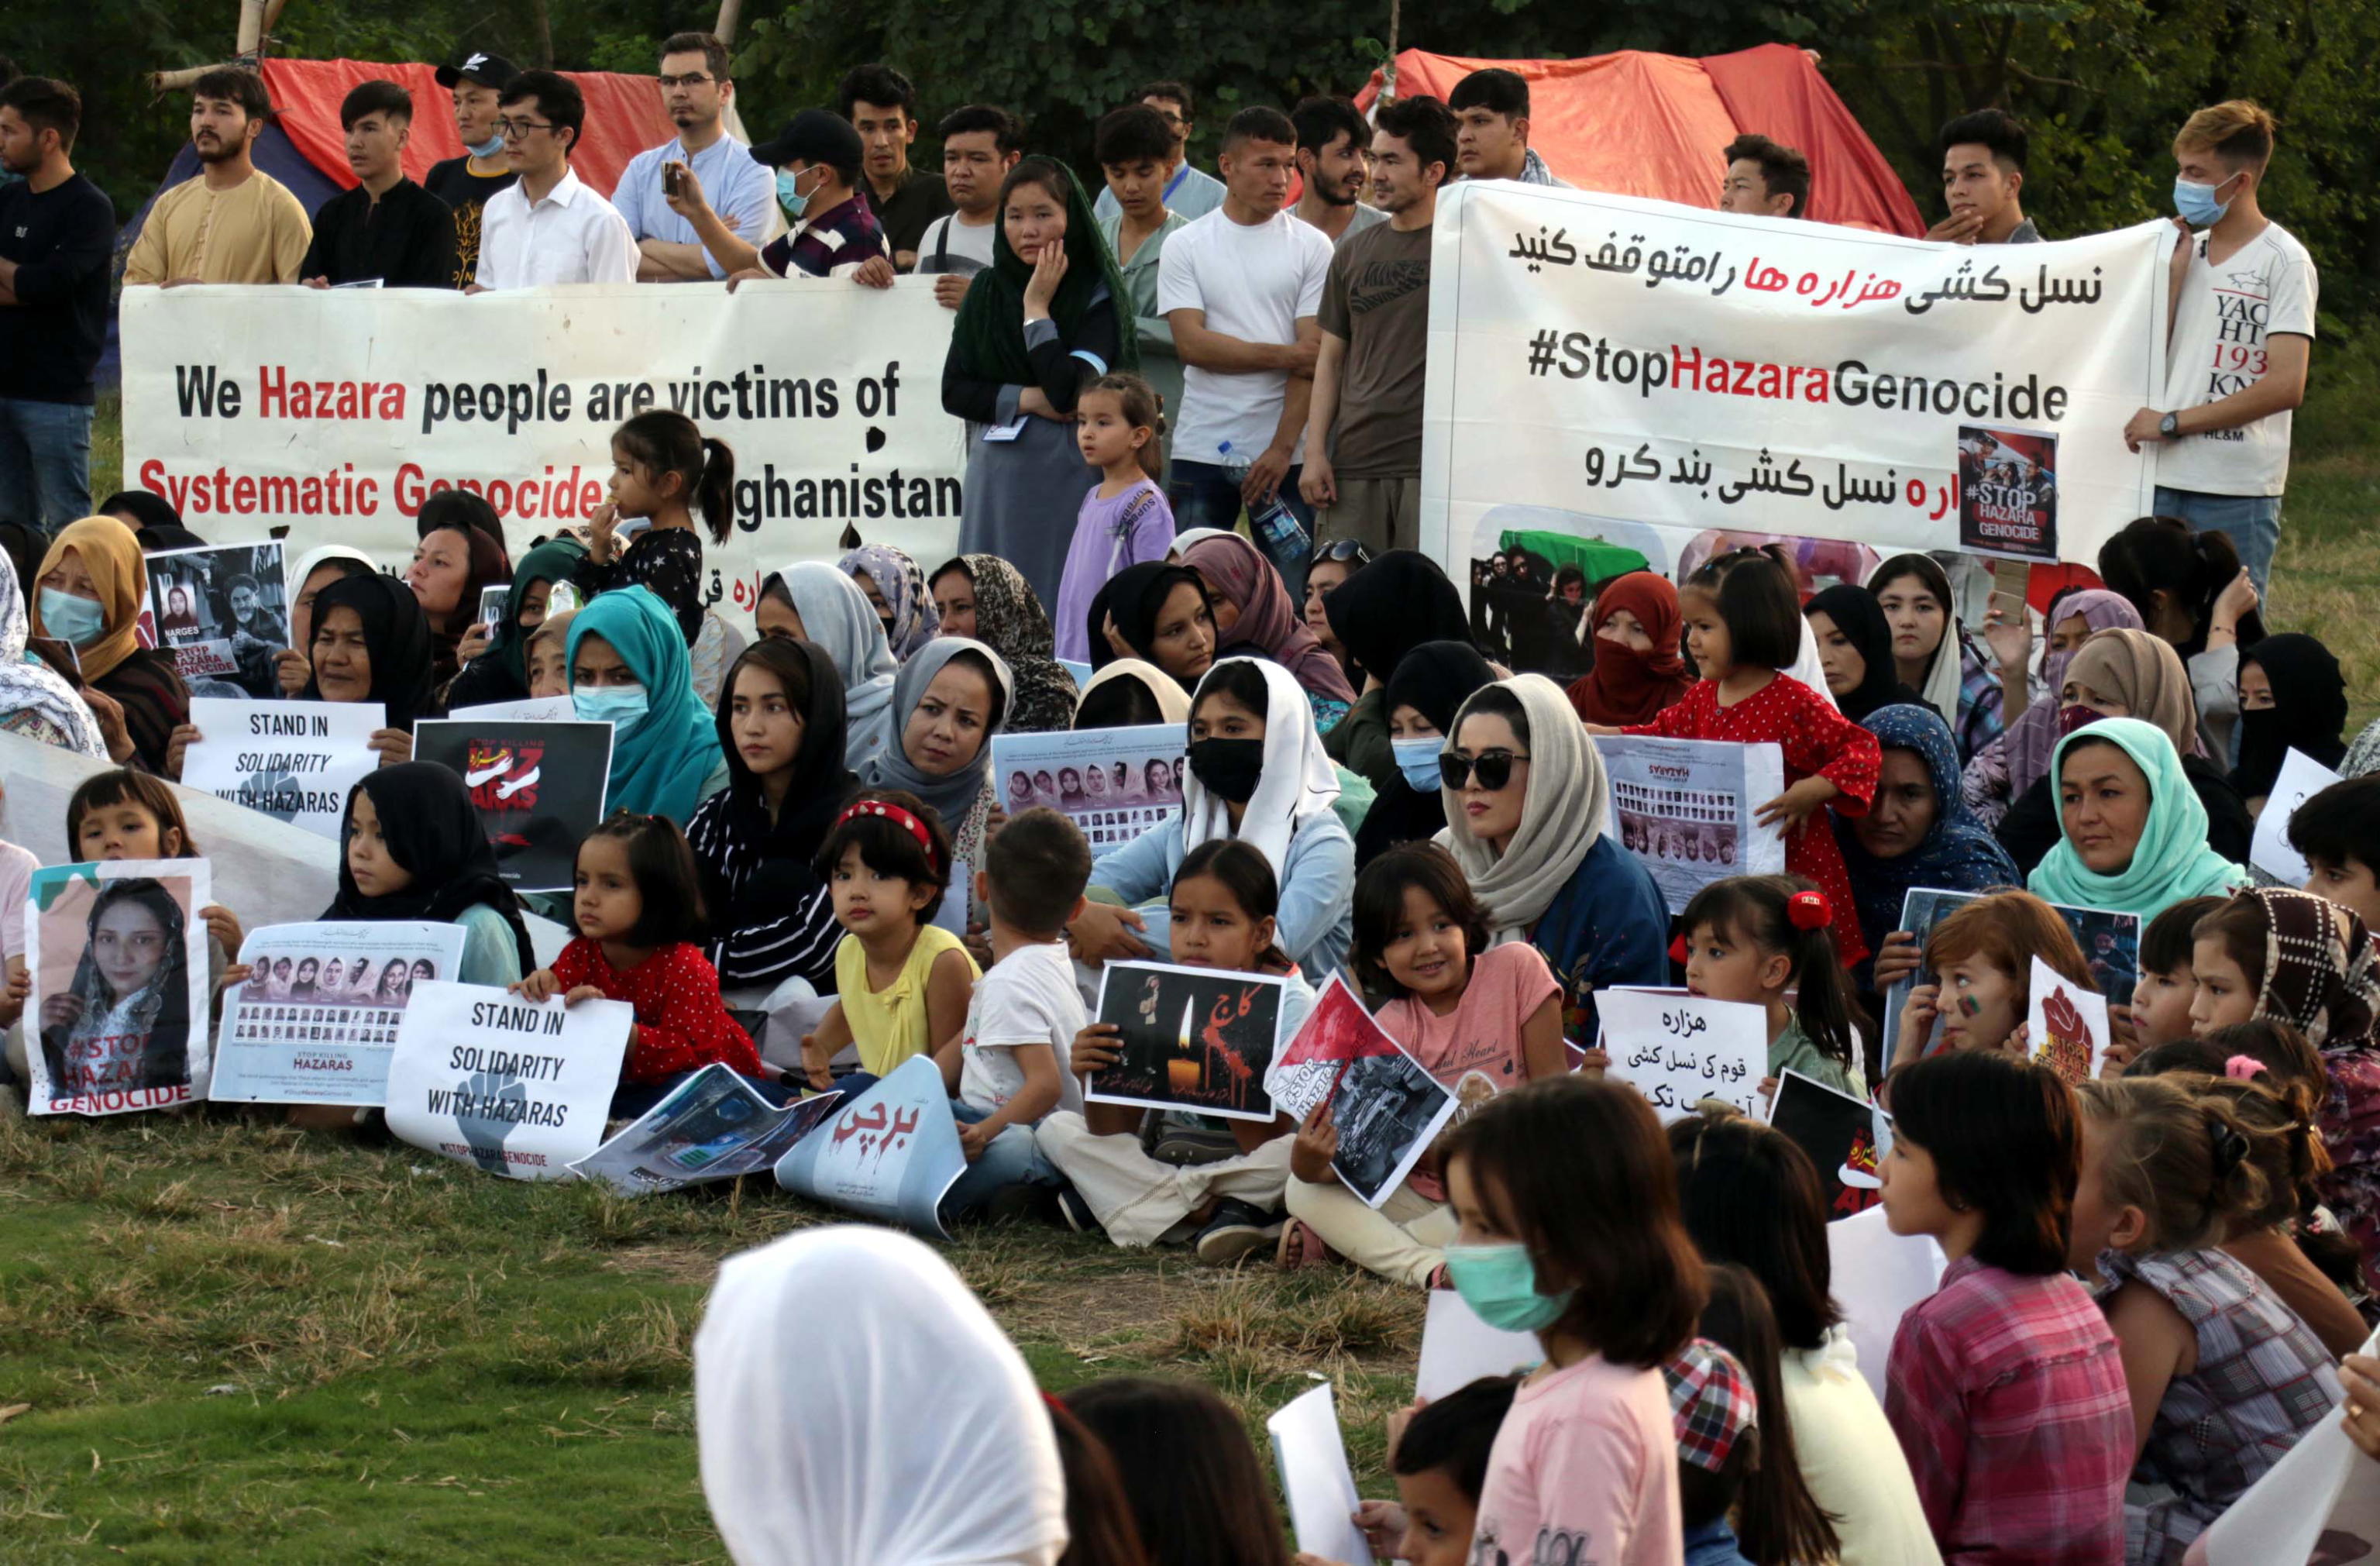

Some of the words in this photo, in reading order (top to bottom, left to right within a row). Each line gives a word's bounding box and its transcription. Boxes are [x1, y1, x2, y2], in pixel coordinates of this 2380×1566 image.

[1508, 225, 1577, 273] کنید
[1744, 256, 1790, 292] ها
[1796, 269, 1903, 308] هزاره
[1904, 259, 2010, 315] کشی
[2021, 264, 2102, 314] نسل
[2218, 318, 2265, 346] HT
[1529, 329, 2068, 422] #StopHazaraGenocide
[175, 365, 241, 418] We
[259, 365, 406, 420] Hazara
[422, 368, 570, 435] people
[586, 382, 655, 422] are
[668, 365, 839, 420] victims
[856, 360, 899, 416] of
[1585, 442, 1661, 488] کرو
[1669, 448, 1712, 499] بند
[1718, 447, 1814, 504] کشی
[139, 458, 378, 518] Systematic
[734, 463, 962, 533] ghanistan
[1823, 463, 1897, 510] نسل
[1905, 473, 1959, 521] اره
[1966, 481, 2038, 512] #STOP
[1979, 504, 2037, 526] HAZARA
[1979, 522, 2040, 541] GENOCIDE
[164, 625, 200, 638] NARGES
[175, 645, 209, 658] STOP
[176, 662, 235, 677] ENOCIDE
[250, 714, 307, 737] STAND
[311, 716, 328, 737] IN
[236, 752, 332, 773] SOLIDARITY
[1649, 765, 1690, 777] HAZARAS
[263, 790, 339, 814] HAZARAS
[471, 1002, 540, 1033] STAND
[543, 1010, 566, 1037] IN
[1663, 1009, 1707, 1038] هزاره
[293, 1058, 353, 1072] HAZARAS
[450, 1045, 565, 1082] SOLIDARITY
[1628, 1045, 1663, 1069] کشی
[1666, 1049, 1697, 1072] نسل
[1701, 1054, 1717, 1079] کی
[1720, 1058, 1746, 1084] قوم
[63, 1060, 144, 1091] HAZA
[1285, 1057, 1316, 1107] #STOP
[1296, 1064, 1333, 1118] Hazara
[49, 1080, 193, 1113] GENOCIDE
[427, 1089, 475, 1118] WITH
[480, 1098, 568, 1128] HAZARAS
